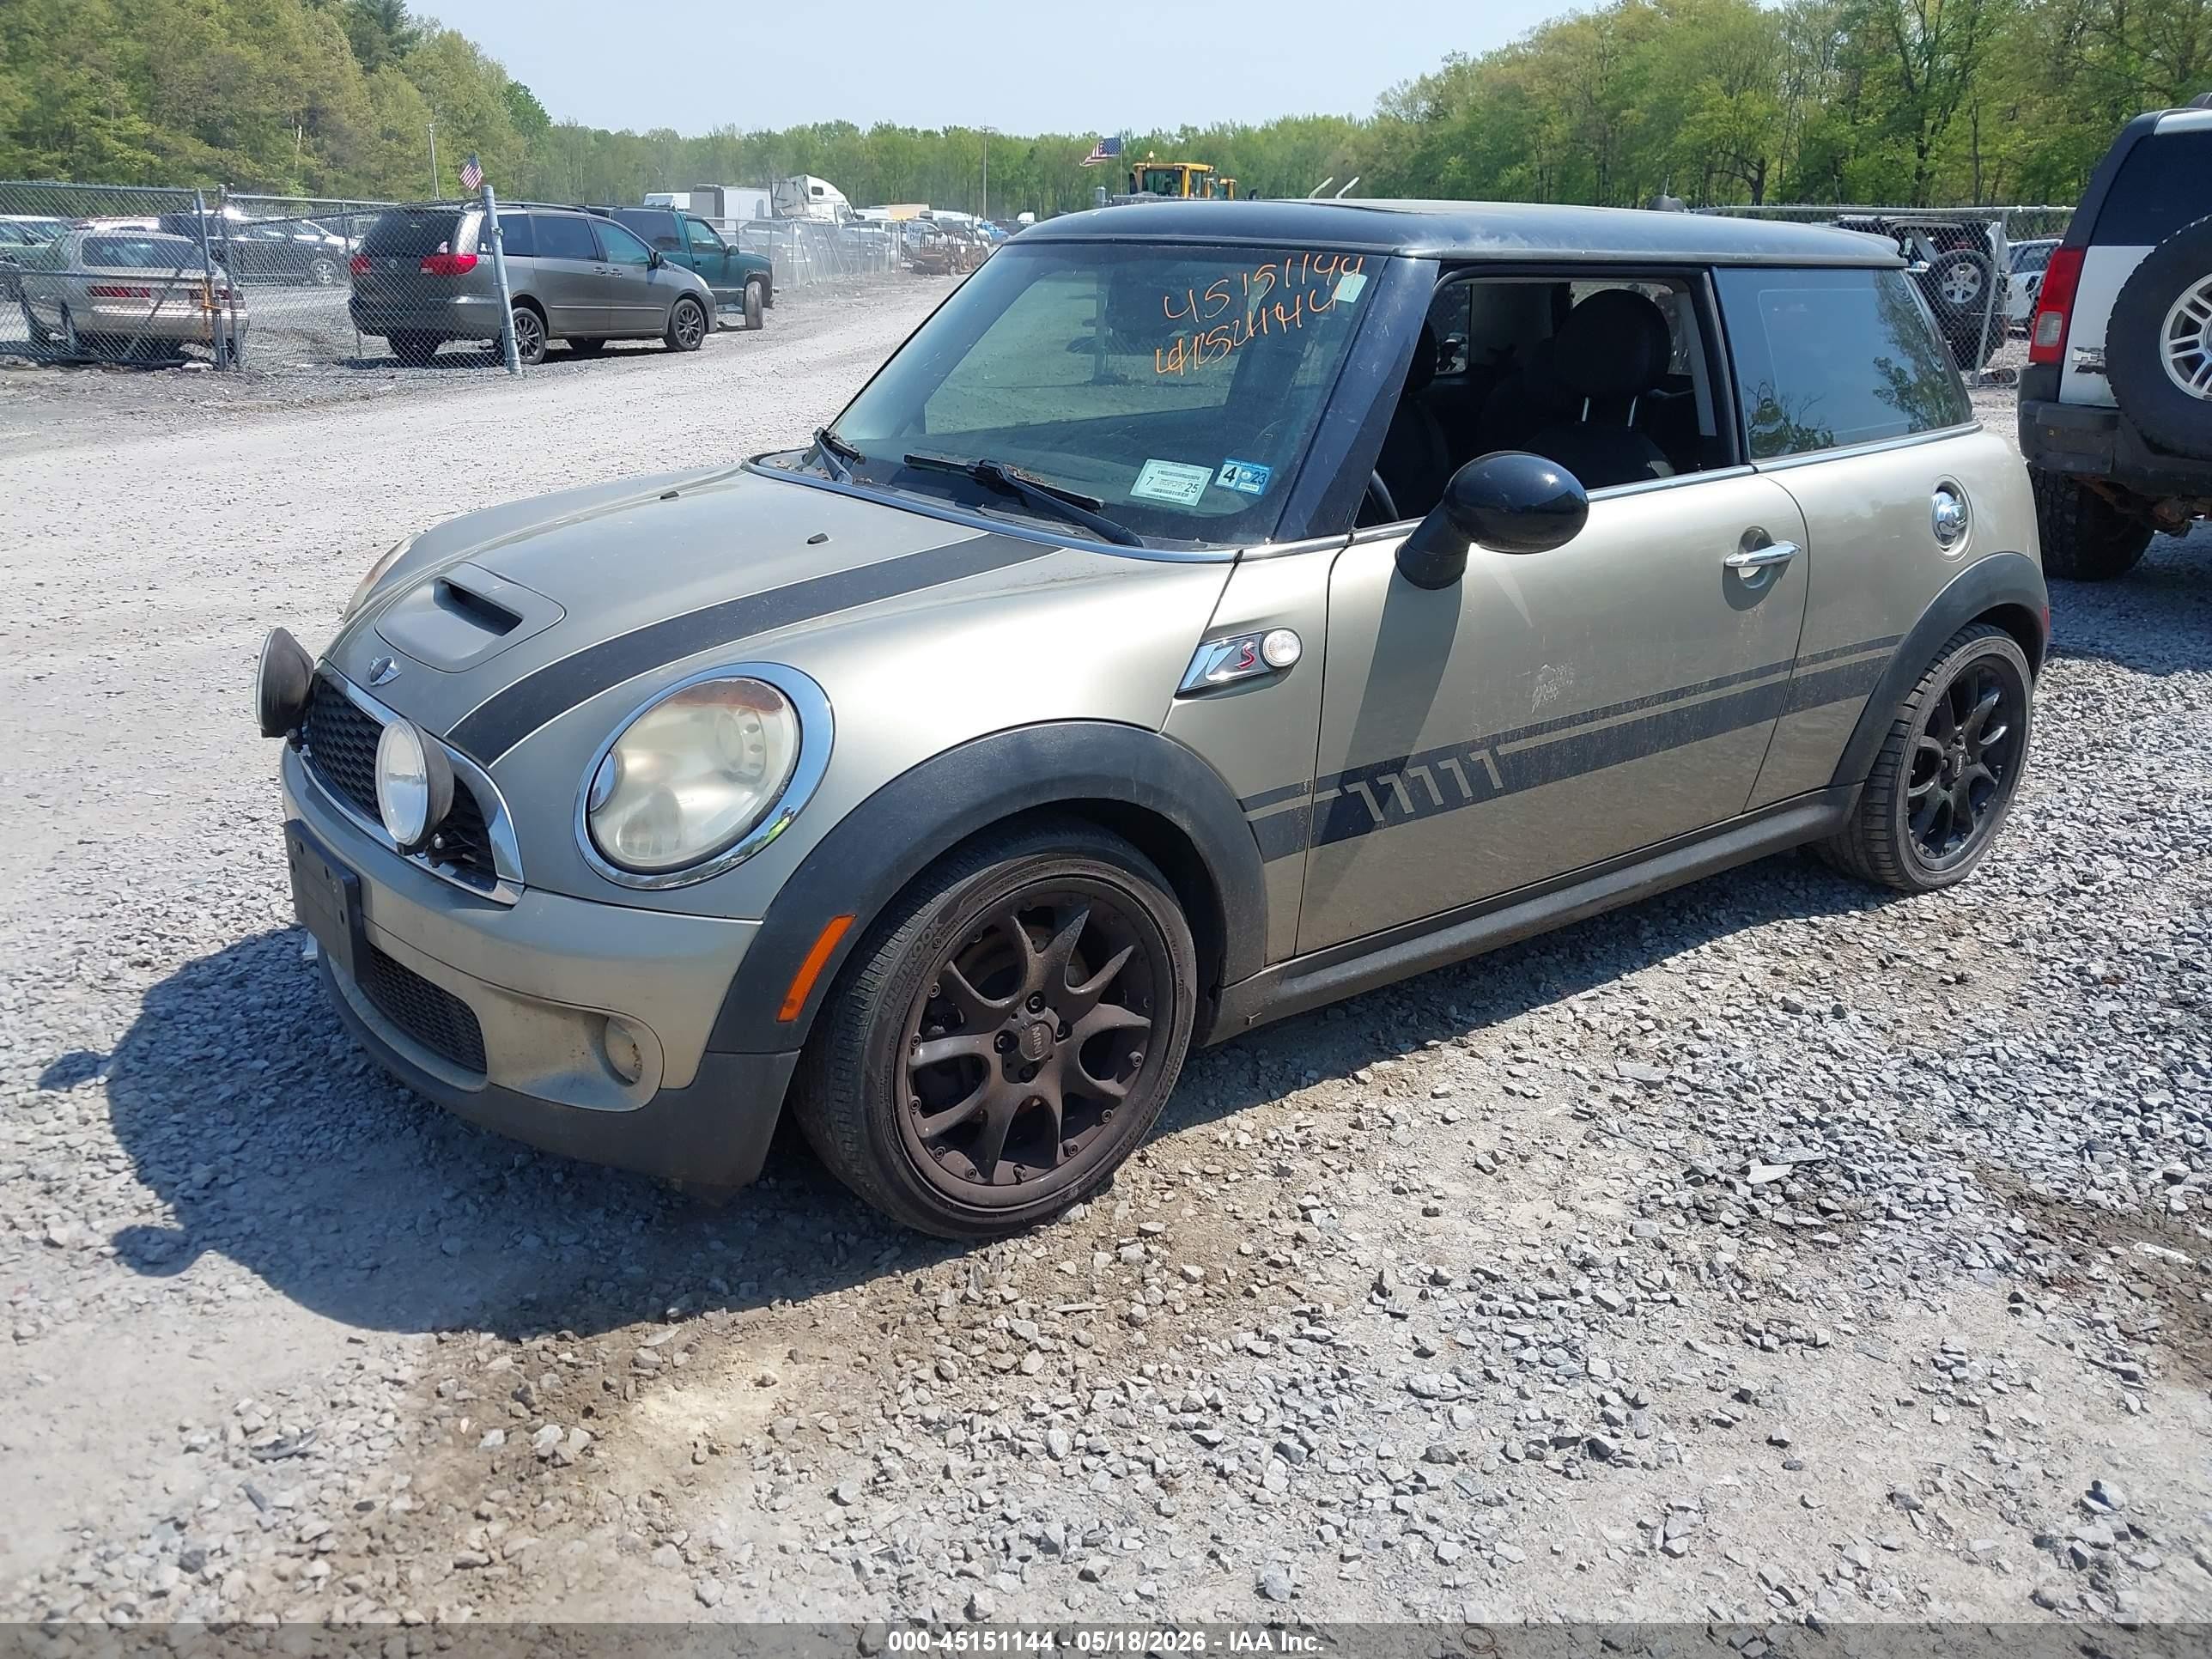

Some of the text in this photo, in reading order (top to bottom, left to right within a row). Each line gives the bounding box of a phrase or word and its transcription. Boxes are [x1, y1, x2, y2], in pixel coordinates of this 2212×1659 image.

[1146, 476, 1155, 486] 7
[1183, 483, 1200, 494] 25
[1223, 466, 1267, 484] 4 23
[1235, 641, 1256, 669] S
[1031, 1026, 1042, 1054] MINI
